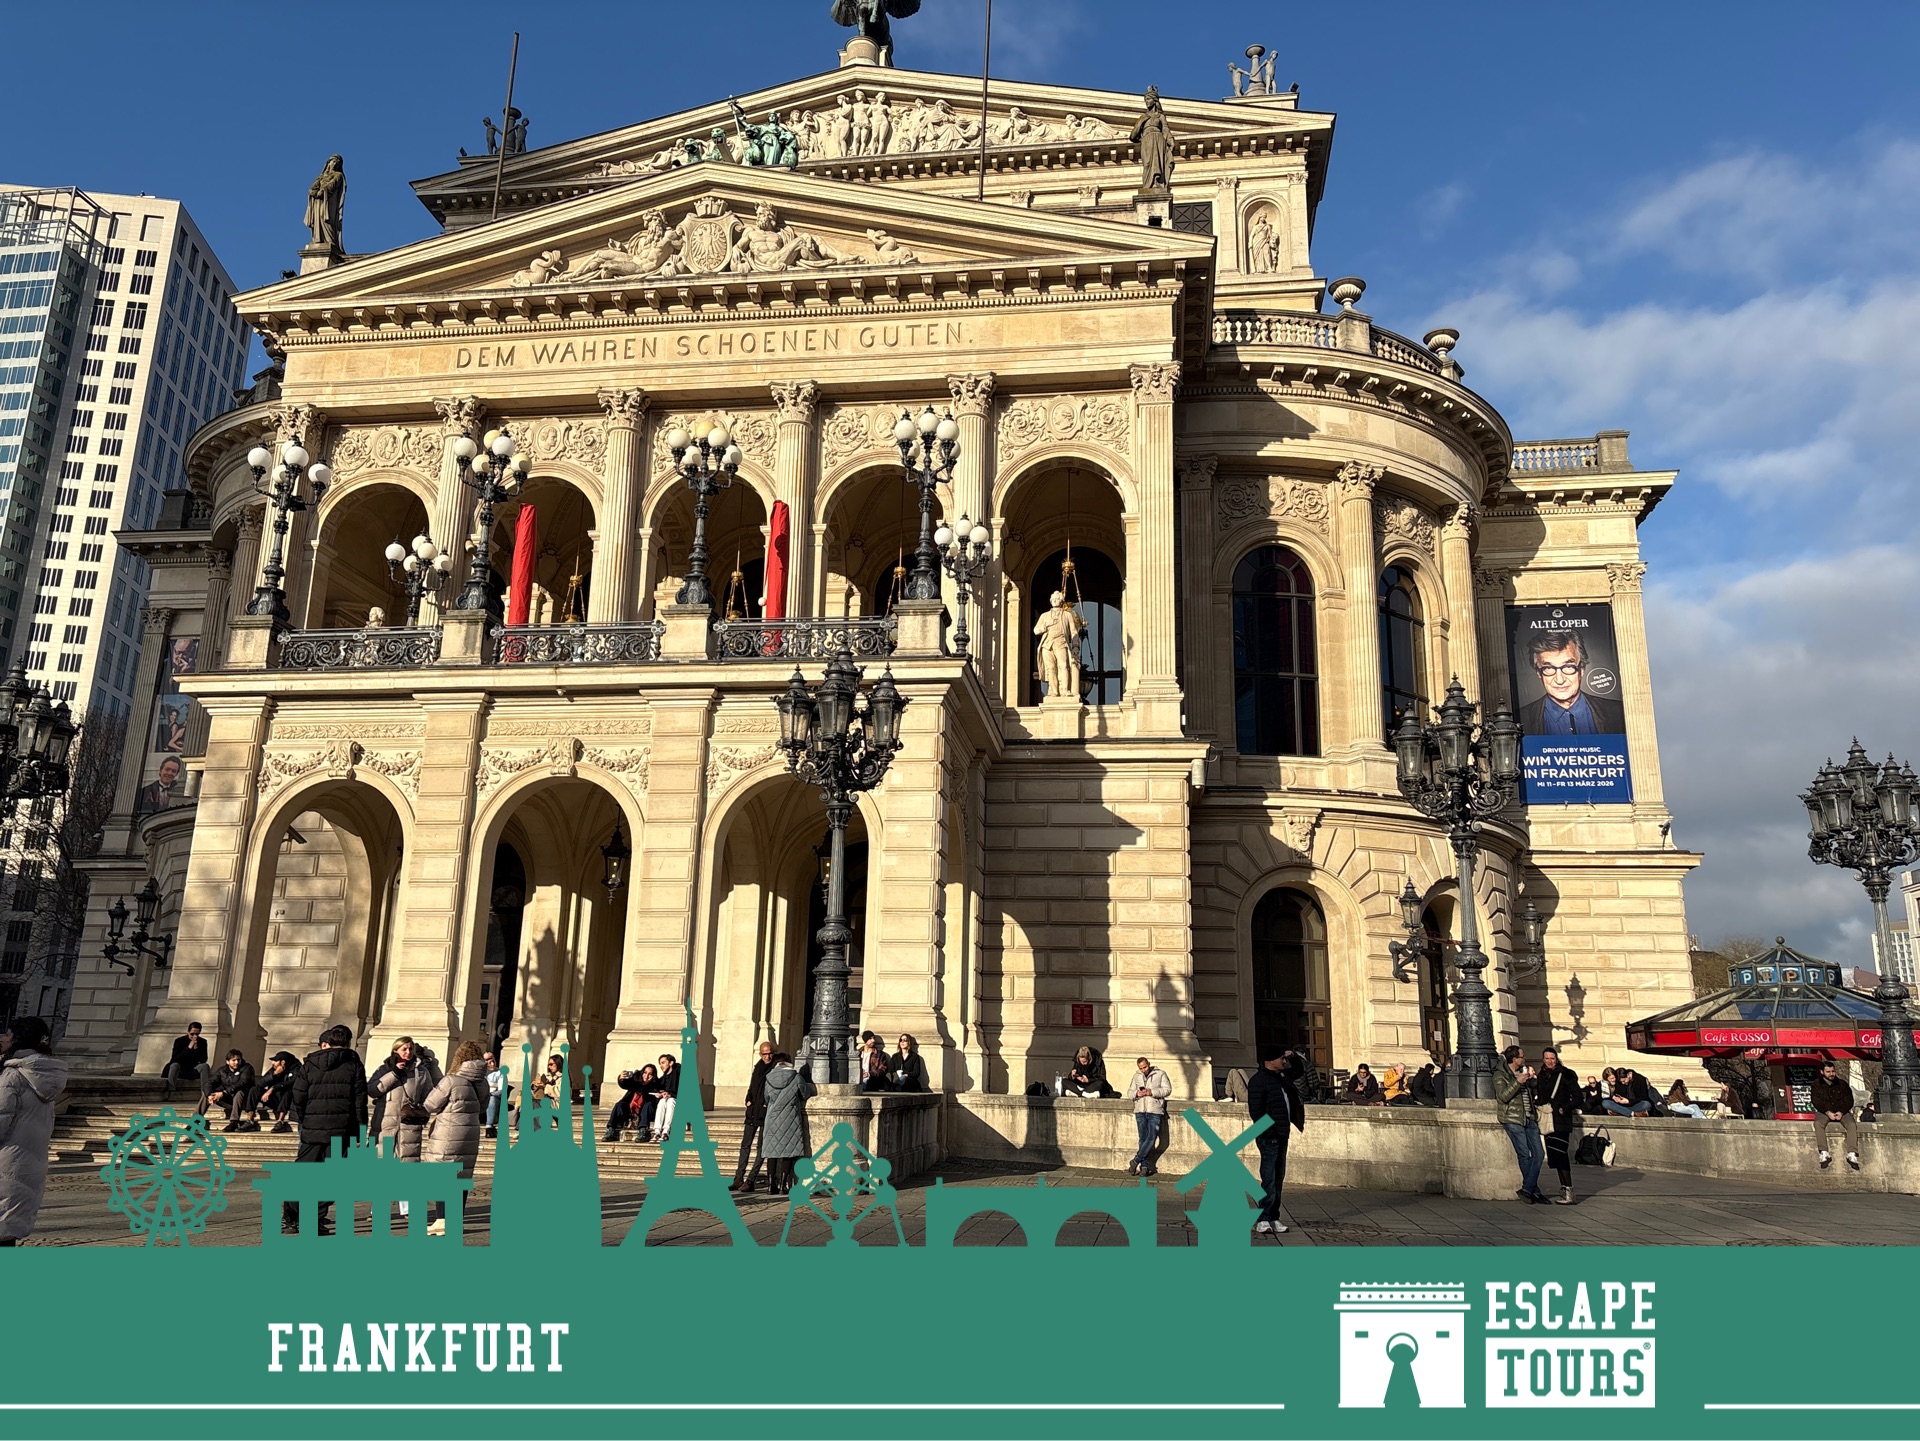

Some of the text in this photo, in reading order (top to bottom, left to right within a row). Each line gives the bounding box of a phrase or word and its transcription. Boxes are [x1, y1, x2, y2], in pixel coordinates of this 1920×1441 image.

[456, 321, 974, 369] DEM WAHREN SCHOENEN GUTEN.
[1530, 619, 1589, 629] ALTE OPER
[1522, 755, 1625, 766] WIM WENDERS
[1524, 768, 1625, 779] IN FRANKFURT
[1730, 1032, 1770, 1042] ROSSO
